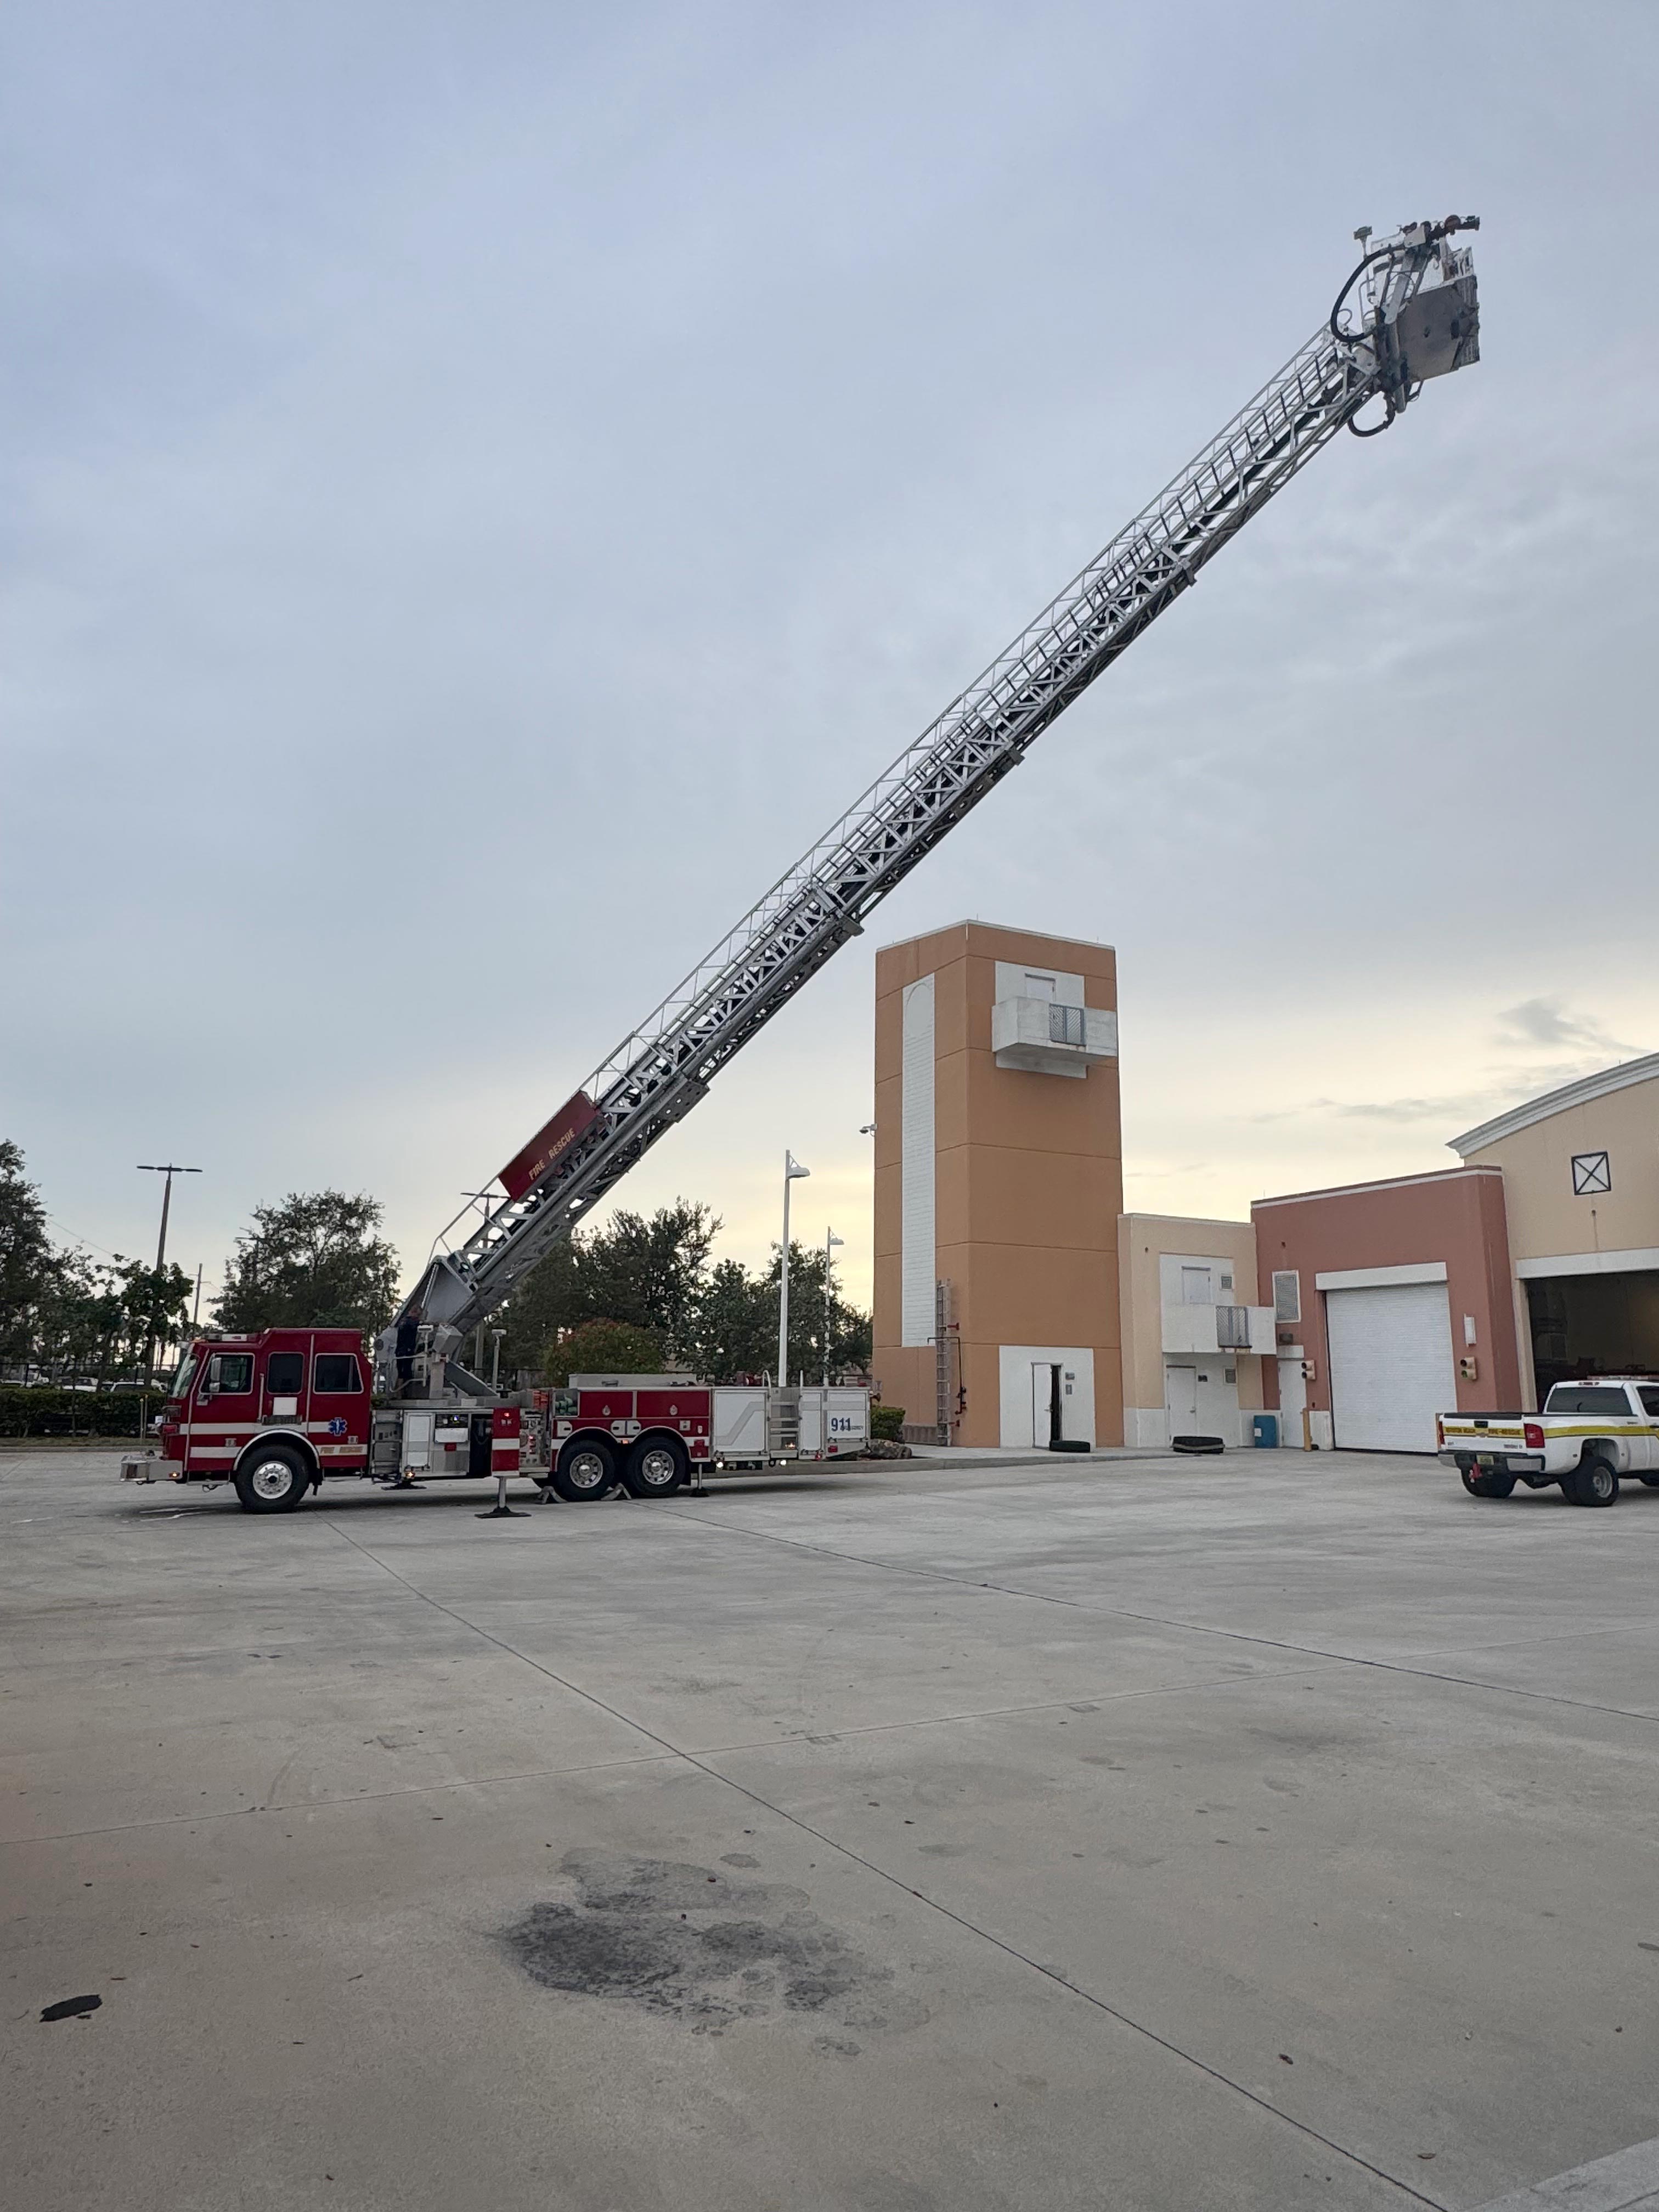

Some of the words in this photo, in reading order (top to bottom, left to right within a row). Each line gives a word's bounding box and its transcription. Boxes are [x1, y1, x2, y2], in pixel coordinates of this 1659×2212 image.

[528, 1159, 545, 1181] FIRE
[549, 1127, 575, 1160] RESCUE
[831, 1418, 850, 1431] 911
